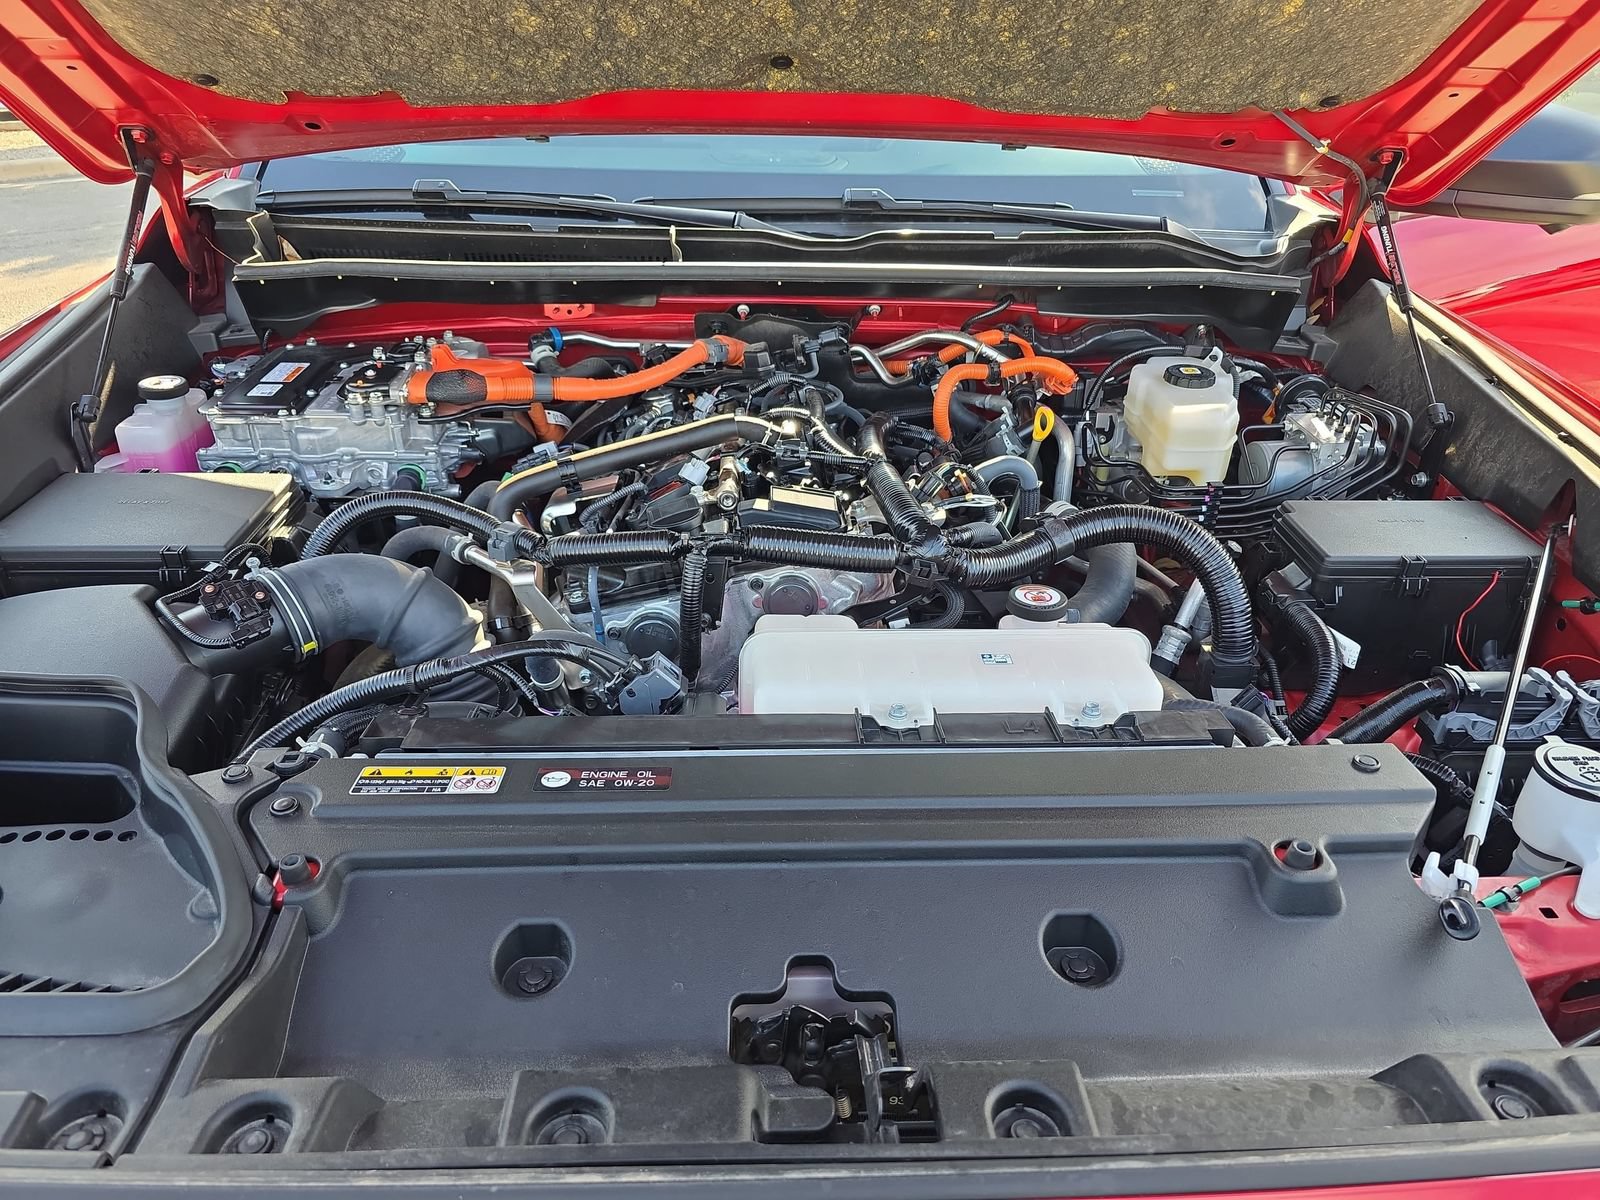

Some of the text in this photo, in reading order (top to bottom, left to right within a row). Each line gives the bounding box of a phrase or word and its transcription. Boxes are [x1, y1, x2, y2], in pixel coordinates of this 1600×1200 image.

[1381, 225, 1393, 253] TUNING
[125, 244, 136, 275] TUNING
[614, 779, 655, 787] 0W-20
[637, 770, 657, 778] OIL
